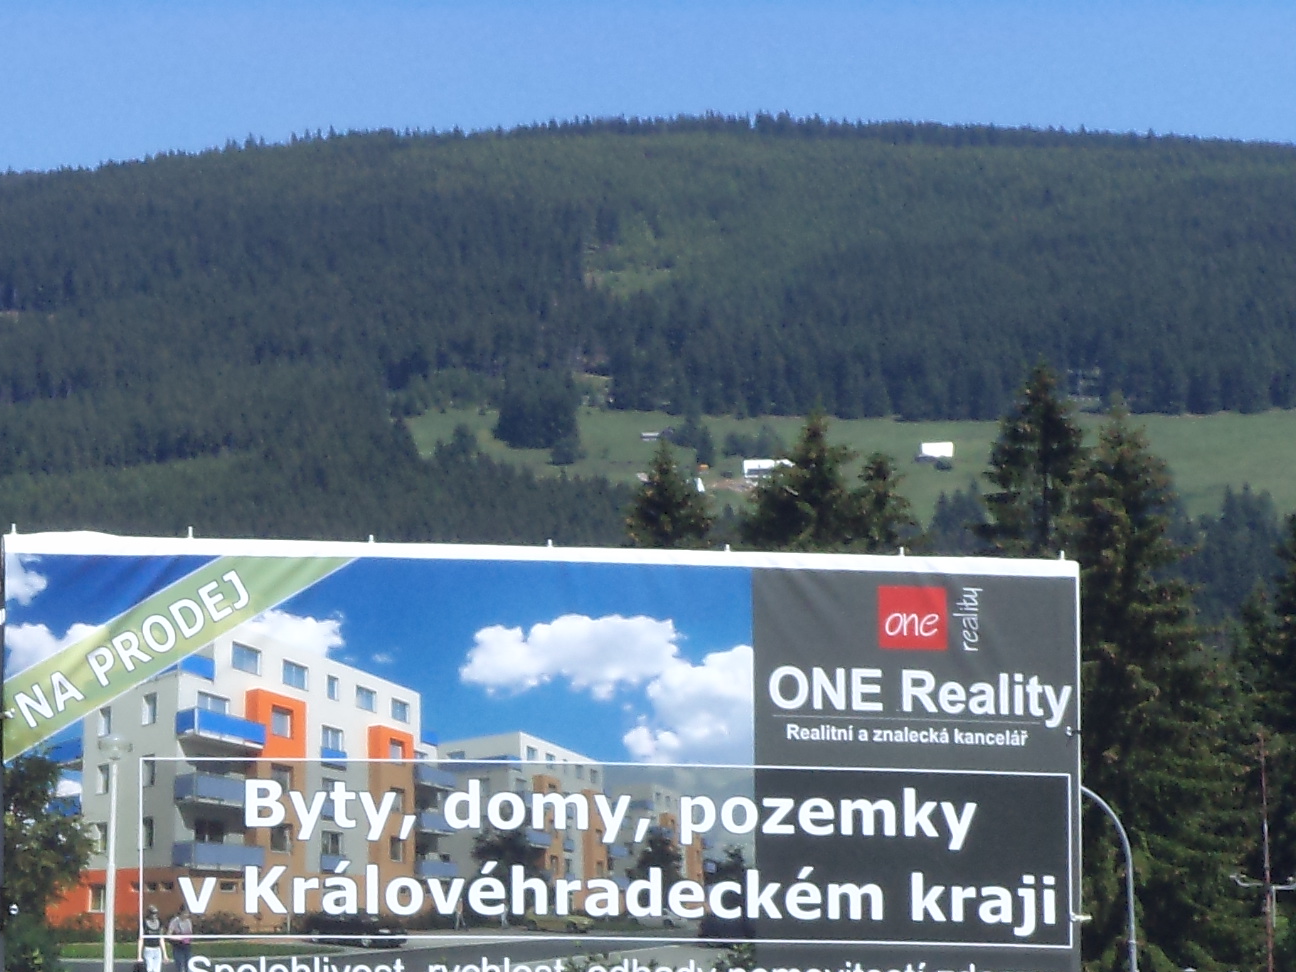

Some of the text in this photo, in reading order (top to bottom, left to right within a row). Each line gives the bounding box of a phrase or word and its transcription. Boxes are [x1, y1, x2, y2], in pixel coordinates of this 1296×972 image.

[13, 569, 253, 729] NA PRODEJ
[884, 611, 940, 638] one
[952, 586, 984, 652] reality
[768, 666, 1073, 728] ONE Reality
[786, 723, 1029, 747] Realitní a znalecká kancelář
[244, 779, 978, 851] Byty, domy, pozemky
[178, 860, 1057, 936] v Královéhradeckém kraji
